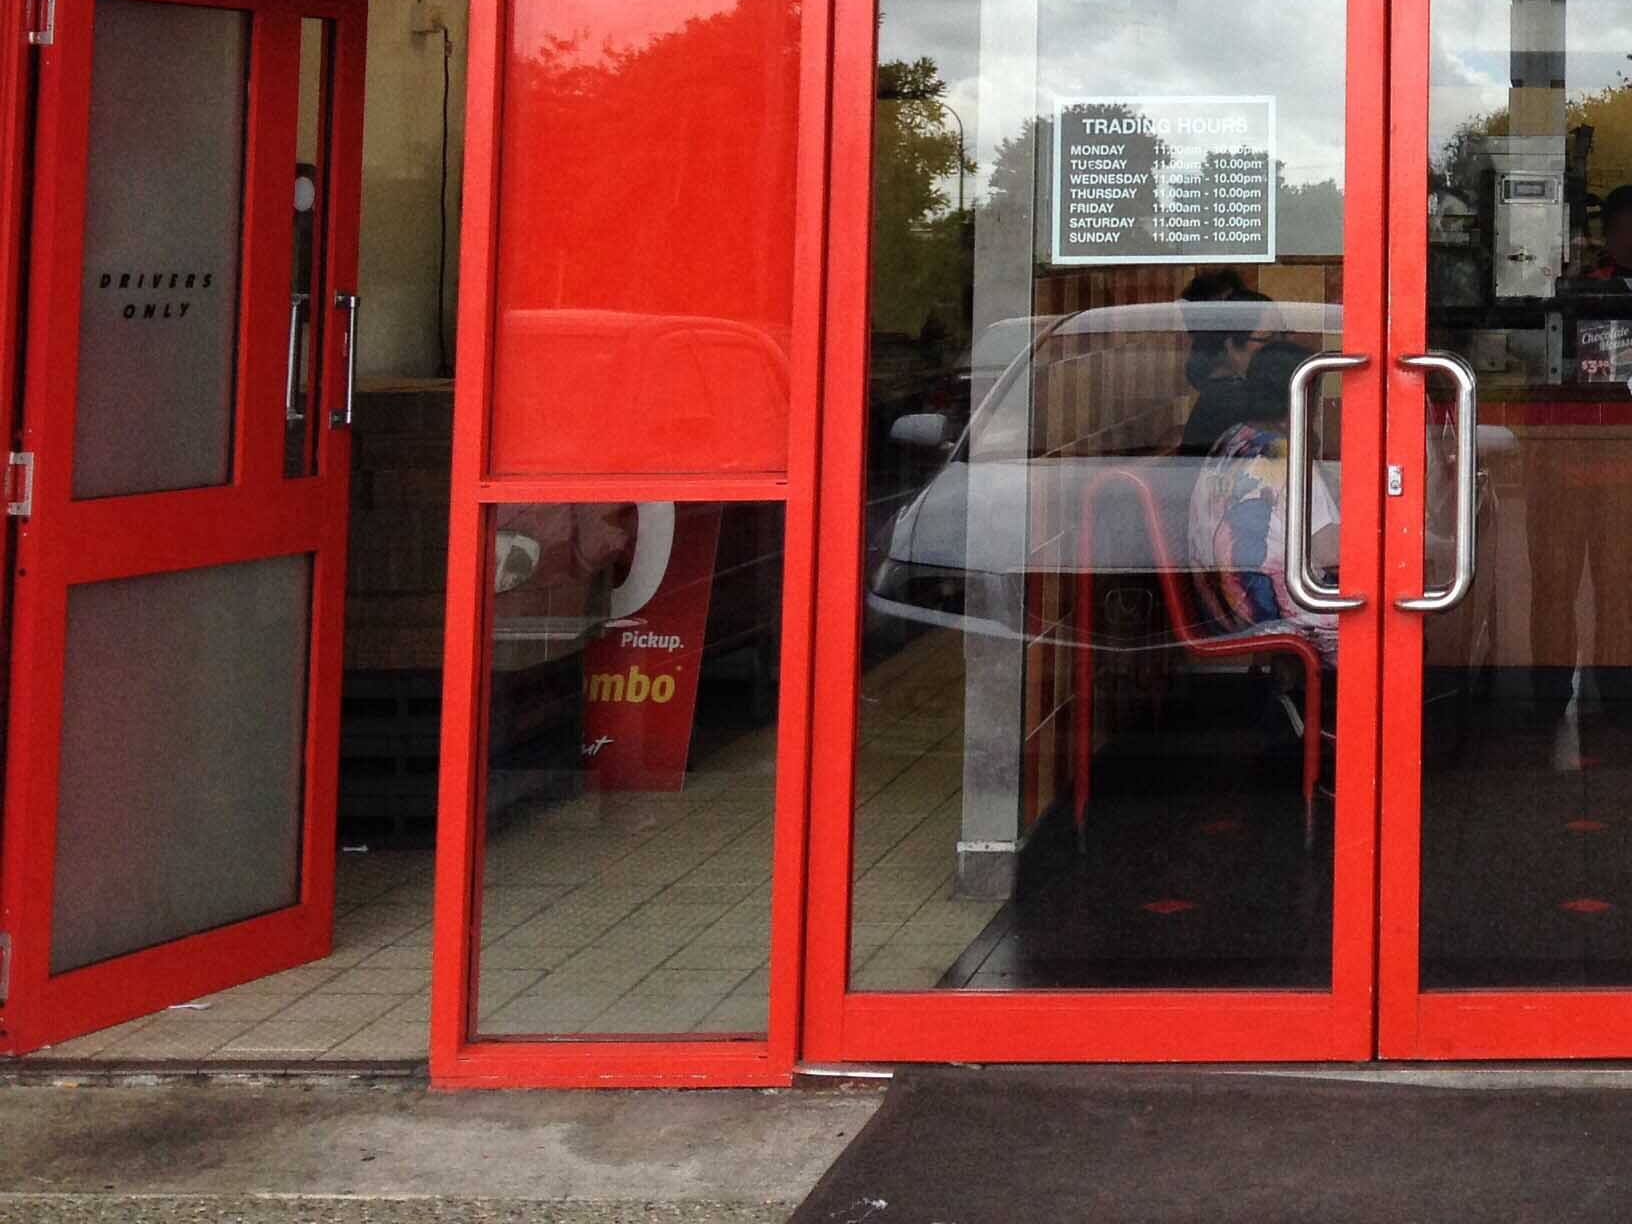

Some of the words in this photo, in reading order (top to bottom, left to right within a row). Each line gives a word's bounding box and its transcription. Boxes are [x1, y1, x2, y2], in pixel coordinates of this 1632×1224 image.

[1082, 118, 1170, 135] TRADING
[1176, 117, 1249, 134] HOURS
[1069, 145, 1125, 156] MONDAY
[1069, 160, 1127, 171] TUESDAY
[1069, 174, 1148, 185] WEDNESDAY
[1069, 188, 1137, 199] THURSDAY
[1153, 188, 1200, 198] 11.00am
[1214, 187, 1262, 199] 10.00pm
[1069, 203, 1114, 214] FRIDAY
[1153, 203, 1200, 213] 11.00am
[1214, 202, 1262, 214] 10.00pm
[1069, 217, 1135, 228] SATURDAY
[1153, 217, 1200, 227] 11.00am
[1214, 216, 1262, 228] 10.00pm
[1069, 232, 1120, 243] SUNDAY
[1153, 232, 1200, 242] 11.00am
[1214, 231, 1262, 243] 10.00pm
[99, 273, 213, 288] DRIVERS
[123, 302, 190, 319] ONLY
[621, 631, 684, 652] Pickup.
[584, 664, 675, 704] mbo
